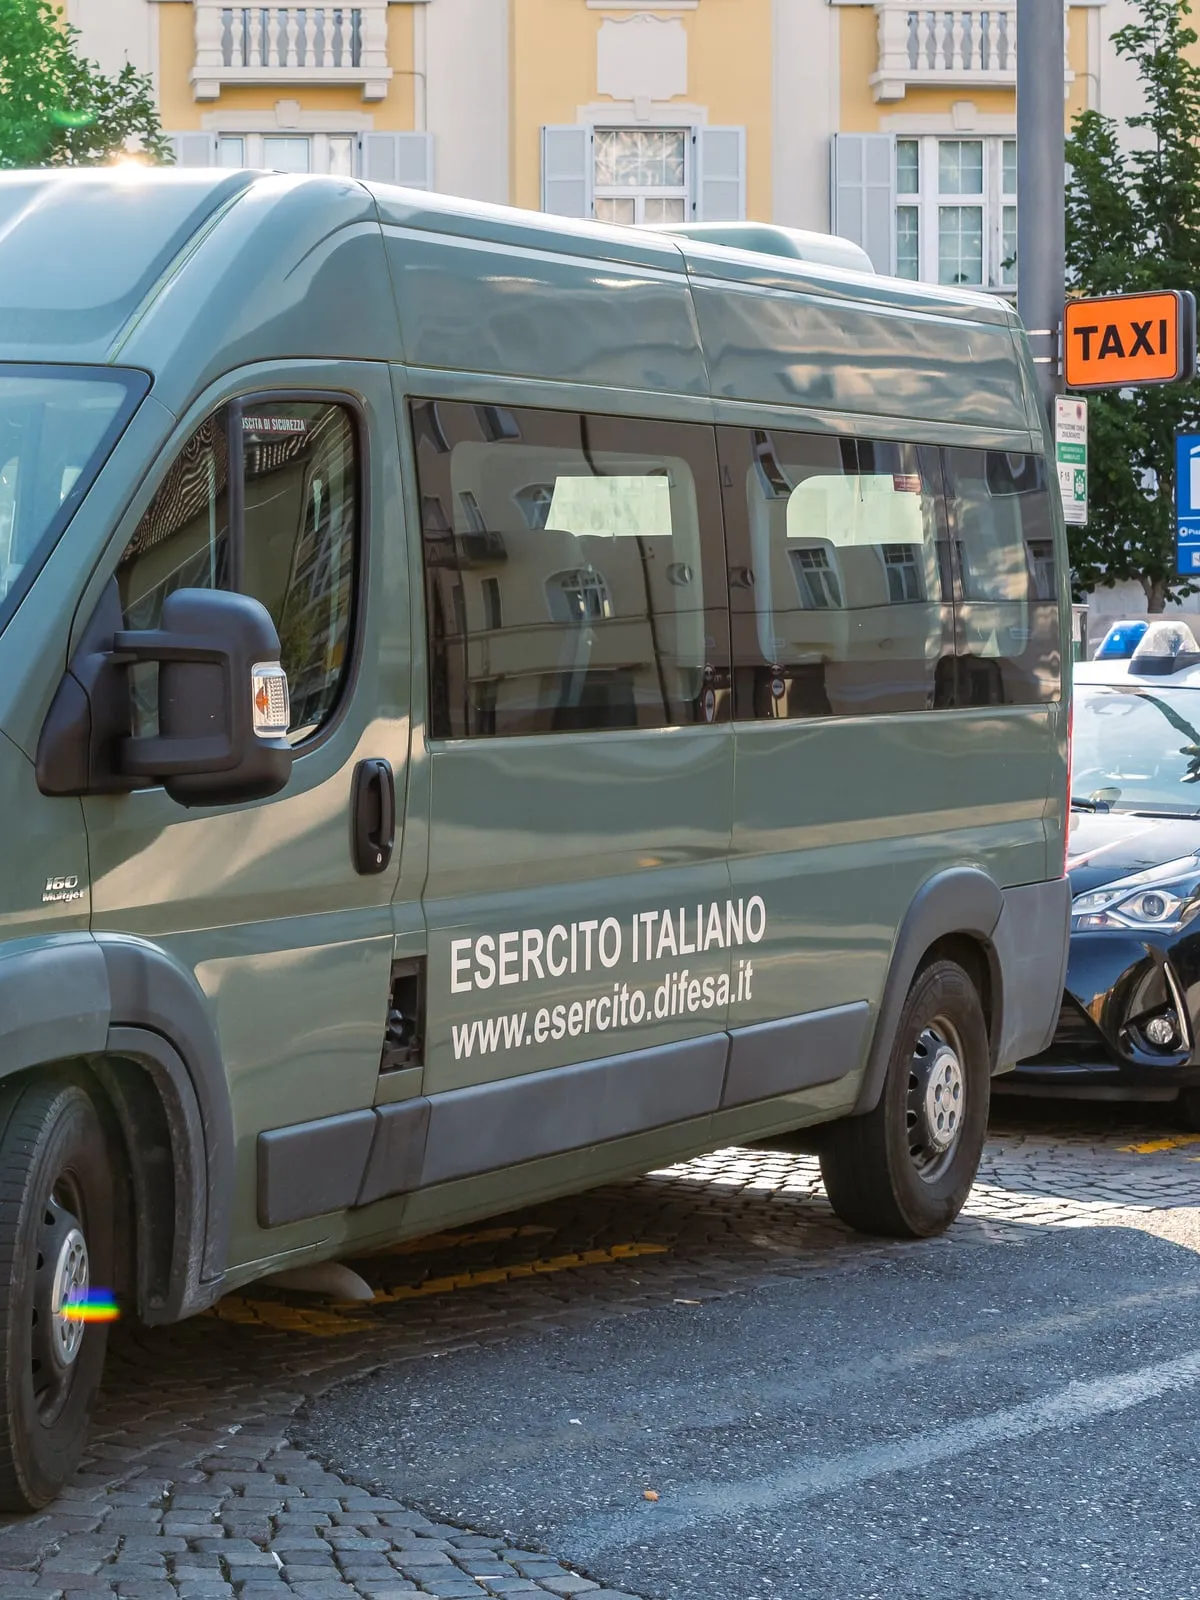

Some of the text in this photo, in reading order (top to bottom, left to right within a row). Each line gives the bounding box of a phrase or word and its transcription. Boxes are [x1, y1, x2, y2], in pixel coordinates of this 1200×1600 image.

[1073, 319, 1167, 361] TAXI
[272, 418, 305, 432] SICUREZZA
[45, 875, 78, 890] 160
[450, 895, 766, 993] ESERCITO ITALIANO
[451, 959, 753, 1060] www.esercito.difesa.it
